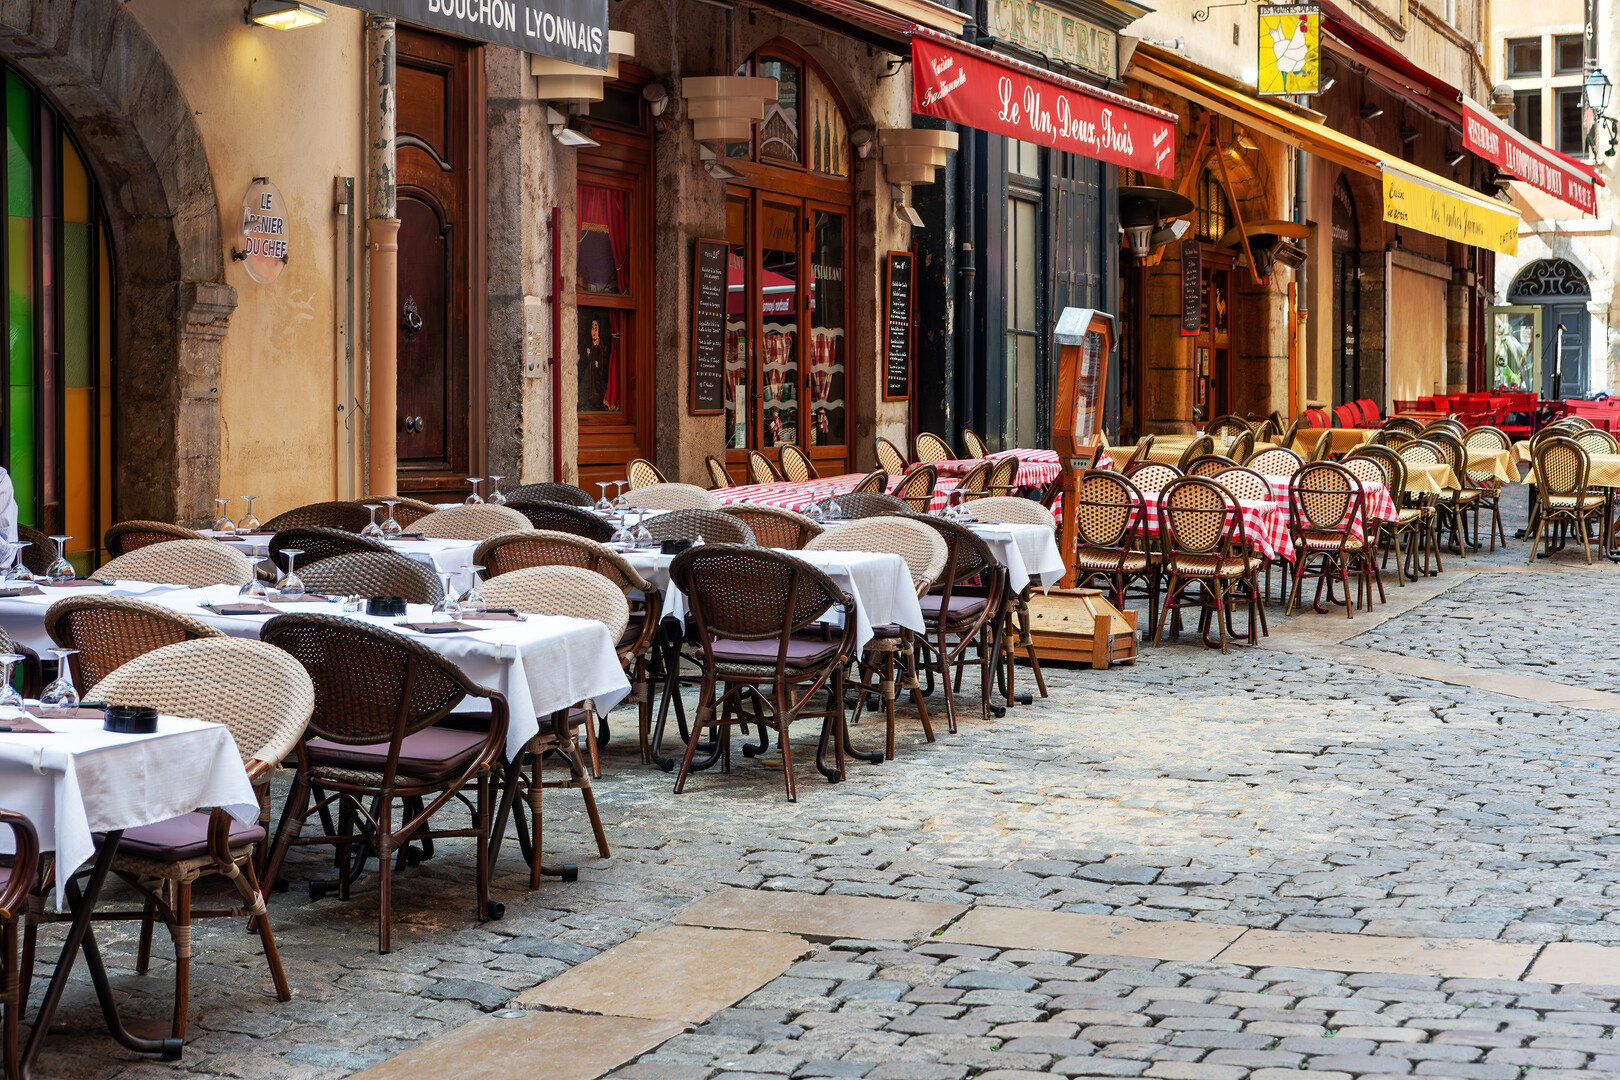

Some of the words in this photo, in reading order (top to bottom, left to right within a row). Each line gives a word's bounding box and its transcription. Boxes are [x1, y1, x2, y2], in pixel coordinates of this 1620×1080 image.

[525, 7, 603, 55] LYONNAIS
[998, 76, 1021, 125] Le
[1023, 85, 1057, 144] Un,
[1056, 94, 1100, 154] Deux,
[1101, 108, 1134, 156] Trois
[1467, 116, 1499, 157] RESTAURANT
[260, 192, 272, 210] LE
[245, 237, 260, 256] DU
[262, 239, 287, 258] CHEF
